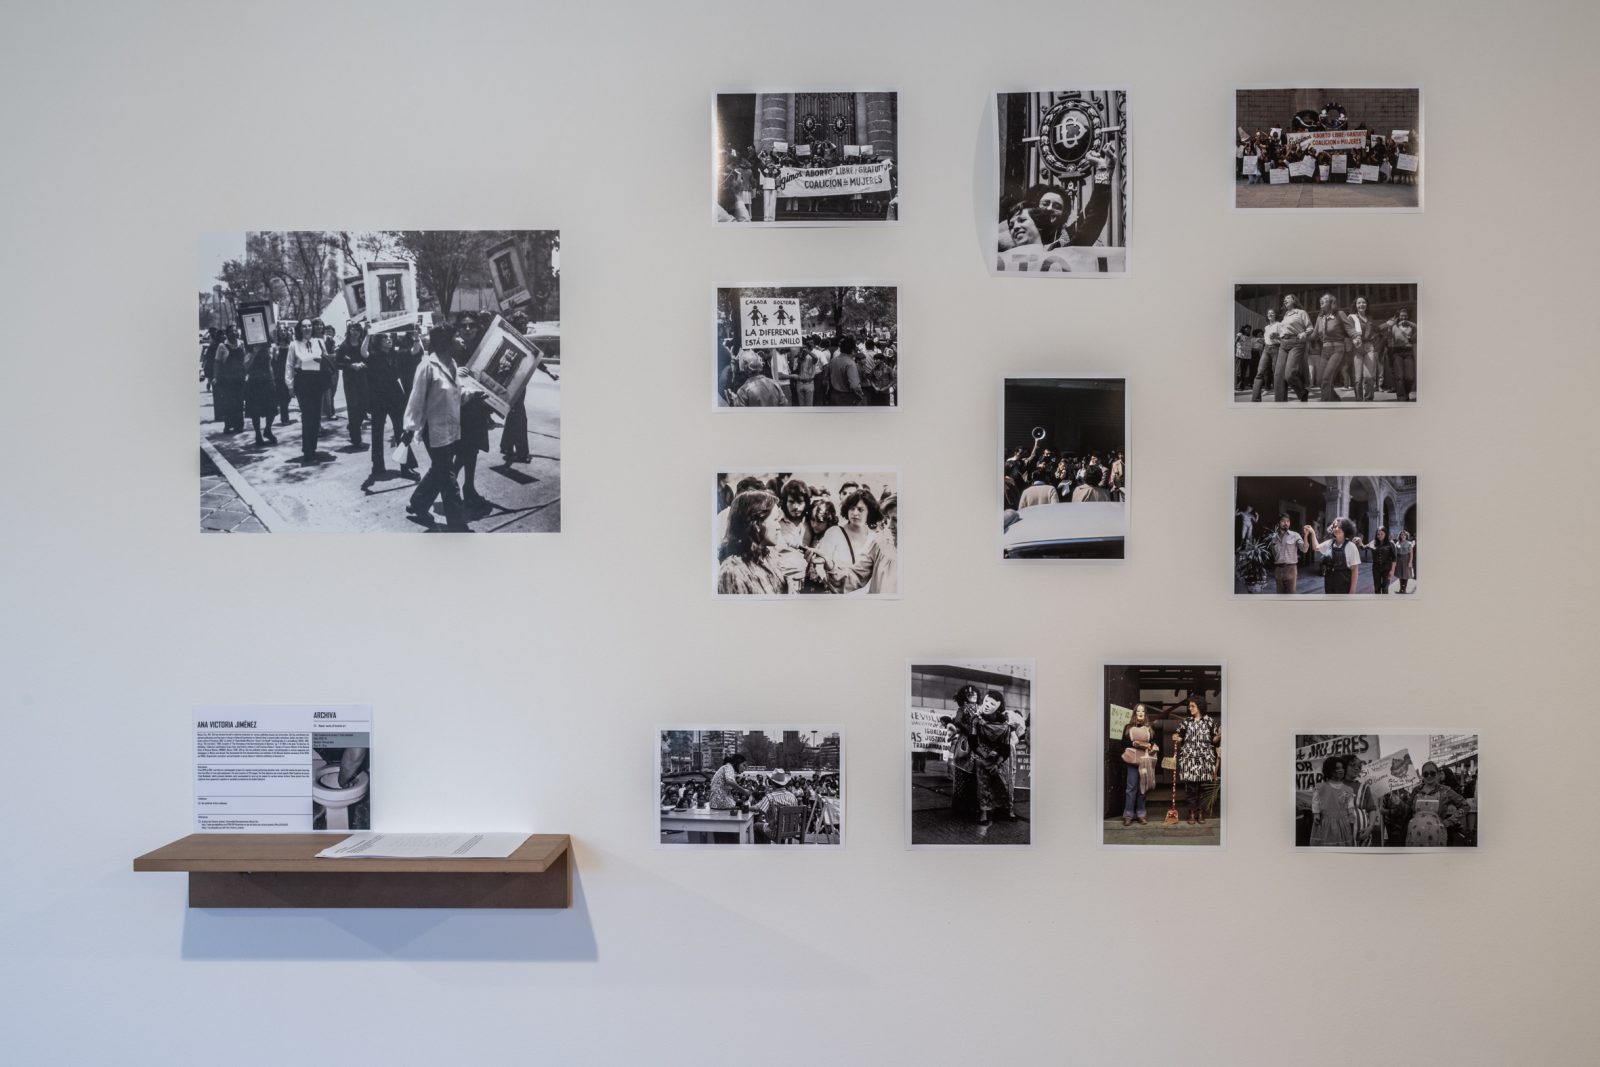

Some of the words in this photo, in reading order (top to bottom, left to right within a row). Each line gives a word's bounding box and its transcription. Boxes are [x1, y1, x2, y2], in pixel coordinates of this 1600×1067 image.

[805, 168, 833, 178] ABORTO
[835, 166, 854, 176] LIBRE
[804, 178, 842, 189] COALICION
[849, 175, 883, 187] MUJERES
[759, 328, 799, 336] DIFERENCIA
[745, 338, 761, 346] ESTÁ
[779, 337, 800, 345] ANILLO
[313, 711, 337, 719] ARCHIVA
[235, 719, 257, 728] JIMÉNEZ
[1308, 735, 1370, 759] MUJERES
